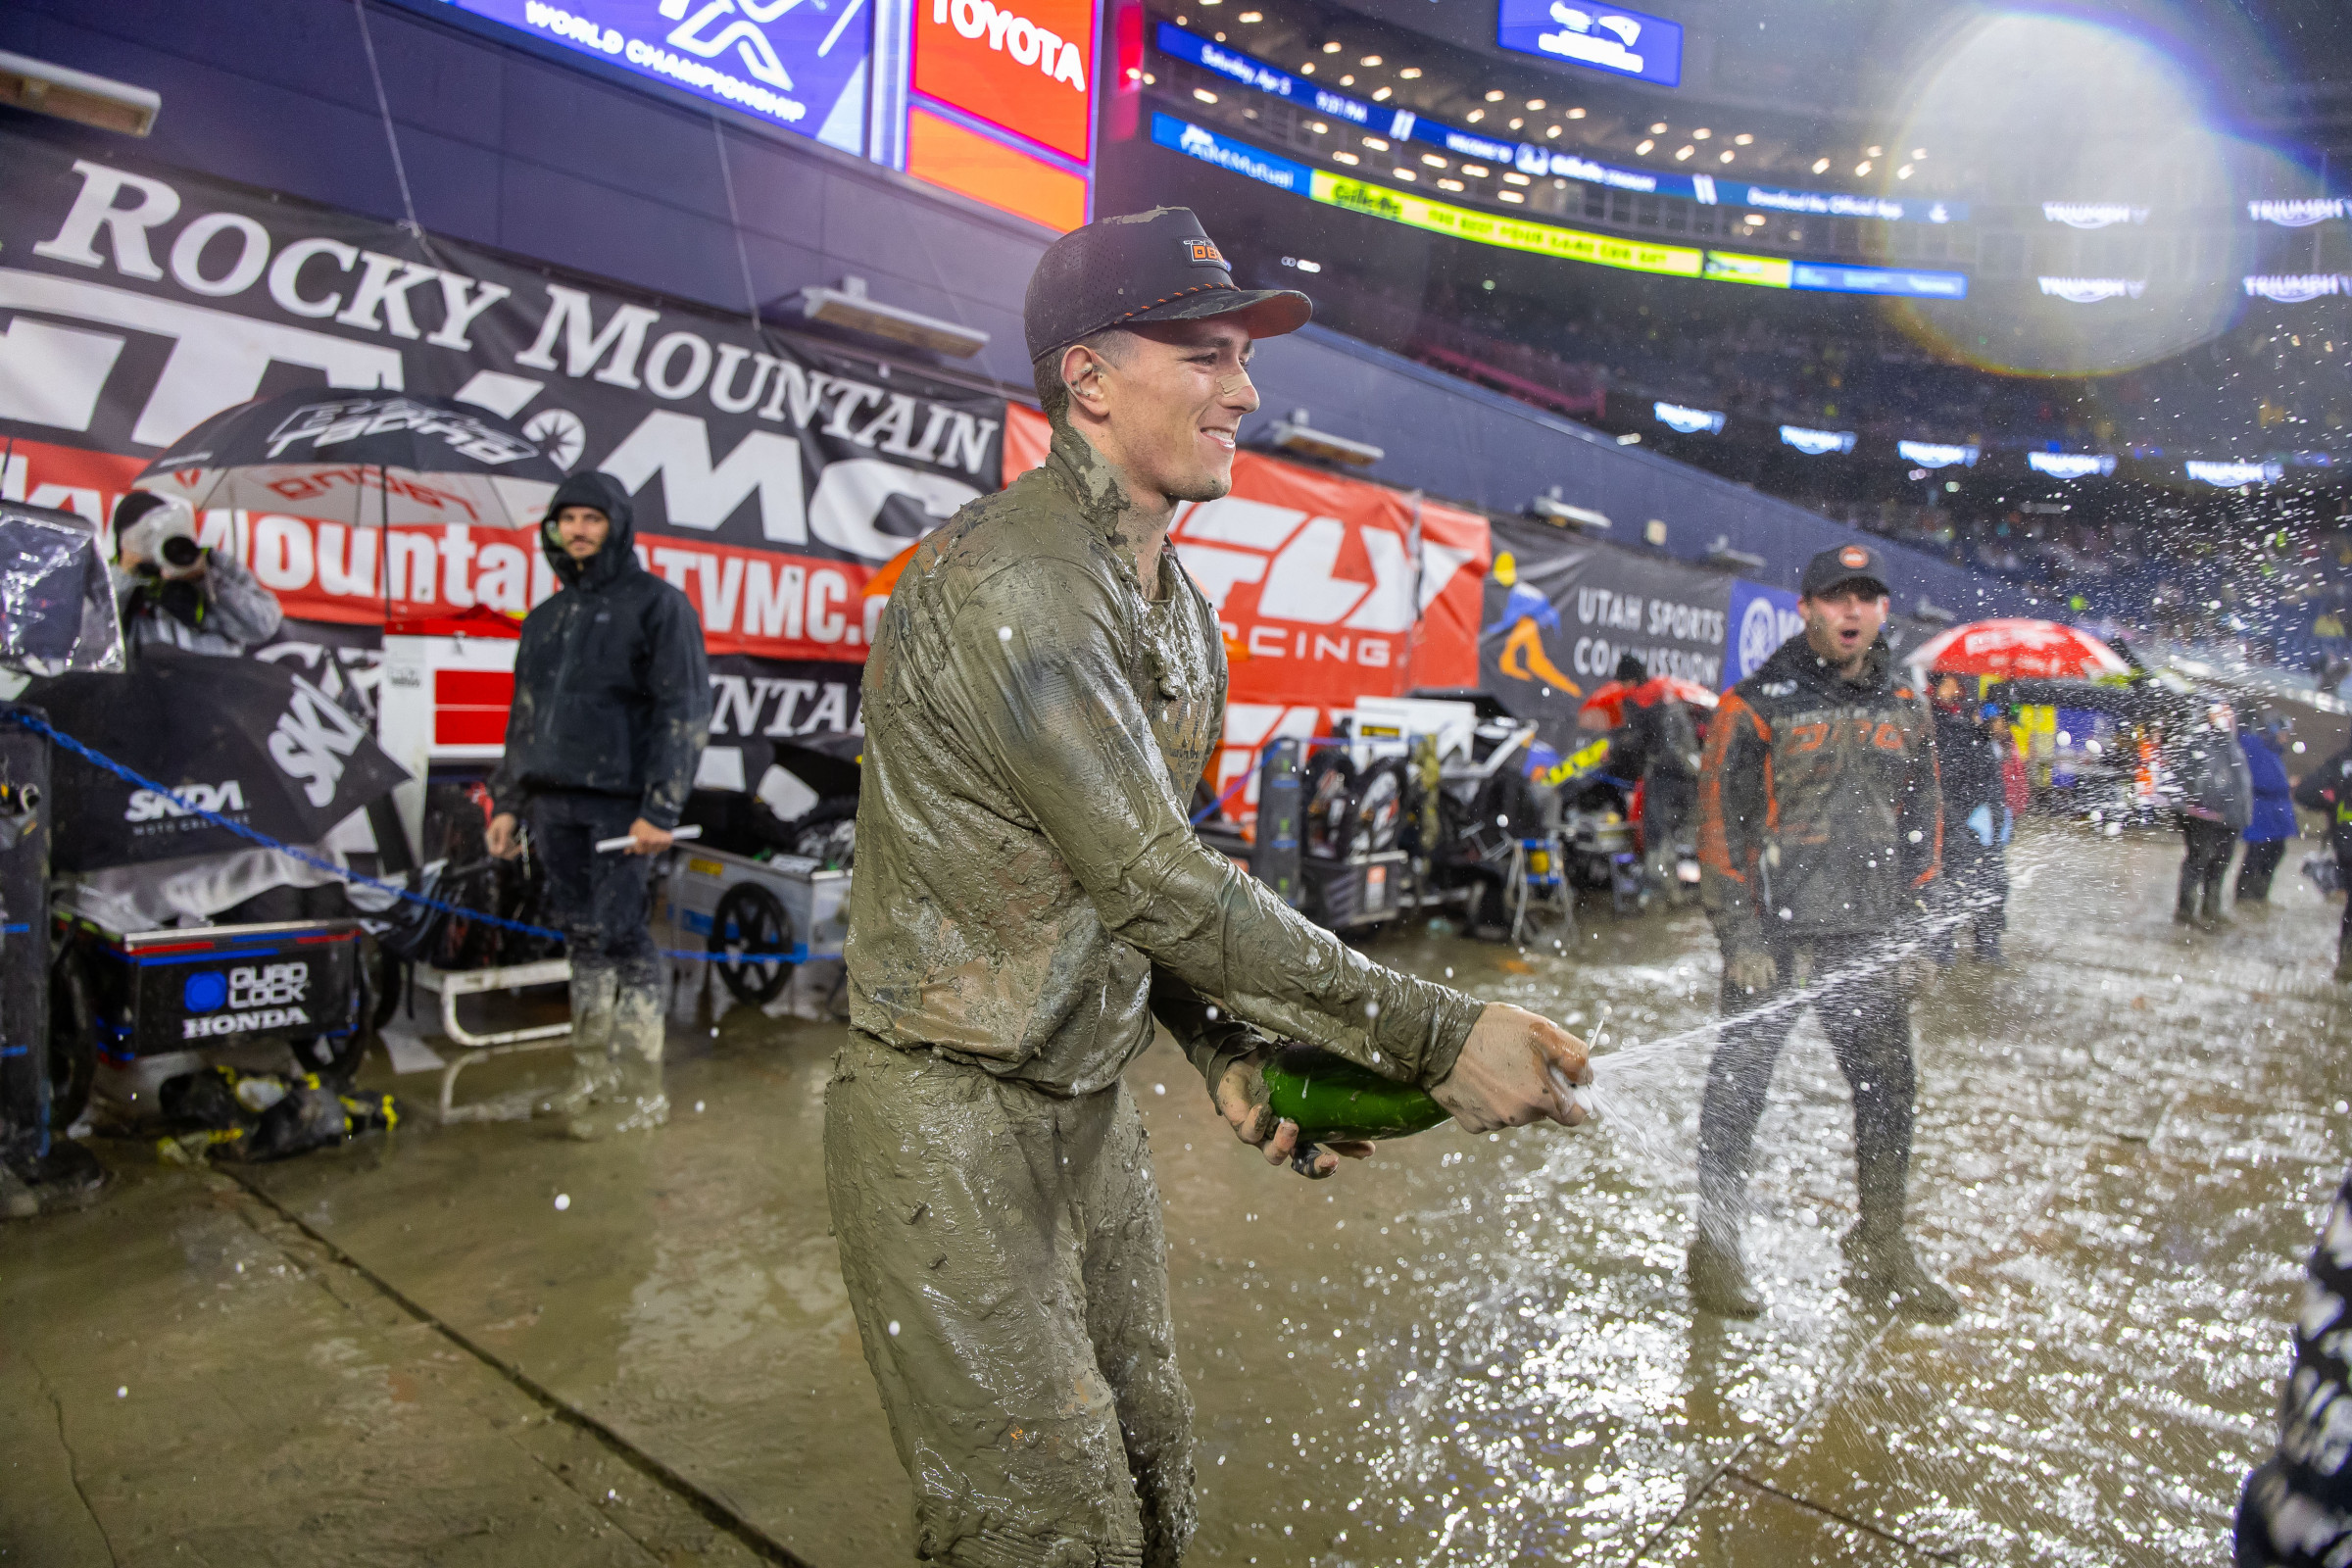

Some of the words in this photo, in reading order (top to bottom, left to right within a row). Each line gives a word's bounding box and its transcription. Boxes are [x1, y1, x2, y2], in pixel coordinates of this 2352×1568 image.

[525, 0, 625, 55] WORLD
[625, 39, 807, 122] CHAMPIONSHIP
[2248, 199, 2344, 220] TRIUMPH
[2242, 273, 2339, 297] TRIUMPH
[32, 159, 511, 352] ROCKY
[515, 283, 999, 474] MOUNTAIN
[1166, 495, 1473, 633] FLY
[1577, 586, 1643, 632] UTAH
[1646, 598, 1725, 646] SPORTS
[1573, 635, 1721, 685] COISSION
[124, 780, 244, 822] SKDA
[227, 982, 307, 1010] LOCK
[228, 960, 309, 990] QUAD
[183, 1006, 311, 1040] HONDA
